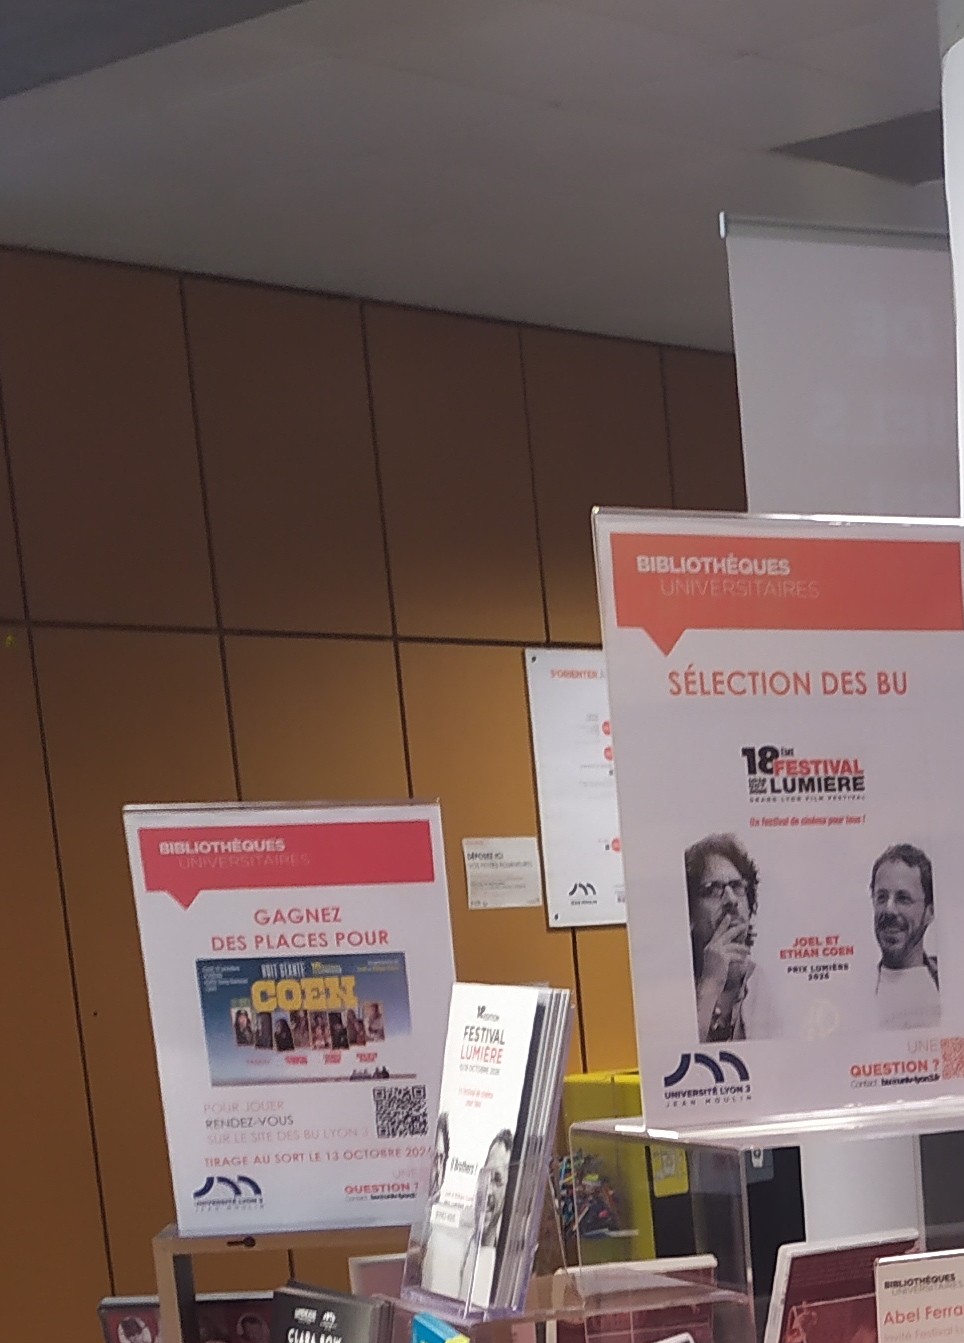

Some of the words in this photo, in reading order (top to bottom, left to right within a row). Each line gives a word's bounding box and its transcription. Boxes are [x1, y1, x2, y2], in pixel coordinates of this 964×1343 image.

[660, 580, 820, 600] UNIVERSITAIRES
[668, 664, 811, 696] SÉLECTION
[822, 671, 868, 695] DES
[877, 671, 908, 695] BU
[773, 758, 865, 777] FESTIVAL
[254, 906, 342, 926] GAGNEZ
[211, 936, 247, 951] DES
[254, 932, 328, 949] PLACES
[335, 930, 389, 946] POUR
[793, 936, 822, 947] JOEL
[780, 948, 819, 959] ETHAN
[252, 975, 358, 1013] COEN
[463, 1025, 505, 1045] FESTIVAL
[850, 1060, 928, 1077] QUESTION
[932, 1058, 940, 1071] ?
[204, 1156, 249, 1168] TIRAGE
[254, 1155, 270, 1165] AU
[274, 1153, 304, 1164] SORT
[309, 1151, 321, 1162] LE
[343, 1149, 401, 1160] OCTOBRE
[344, 1183, 411, 1195] QUESTION
[883, 1309, 920, 1326] Abel
